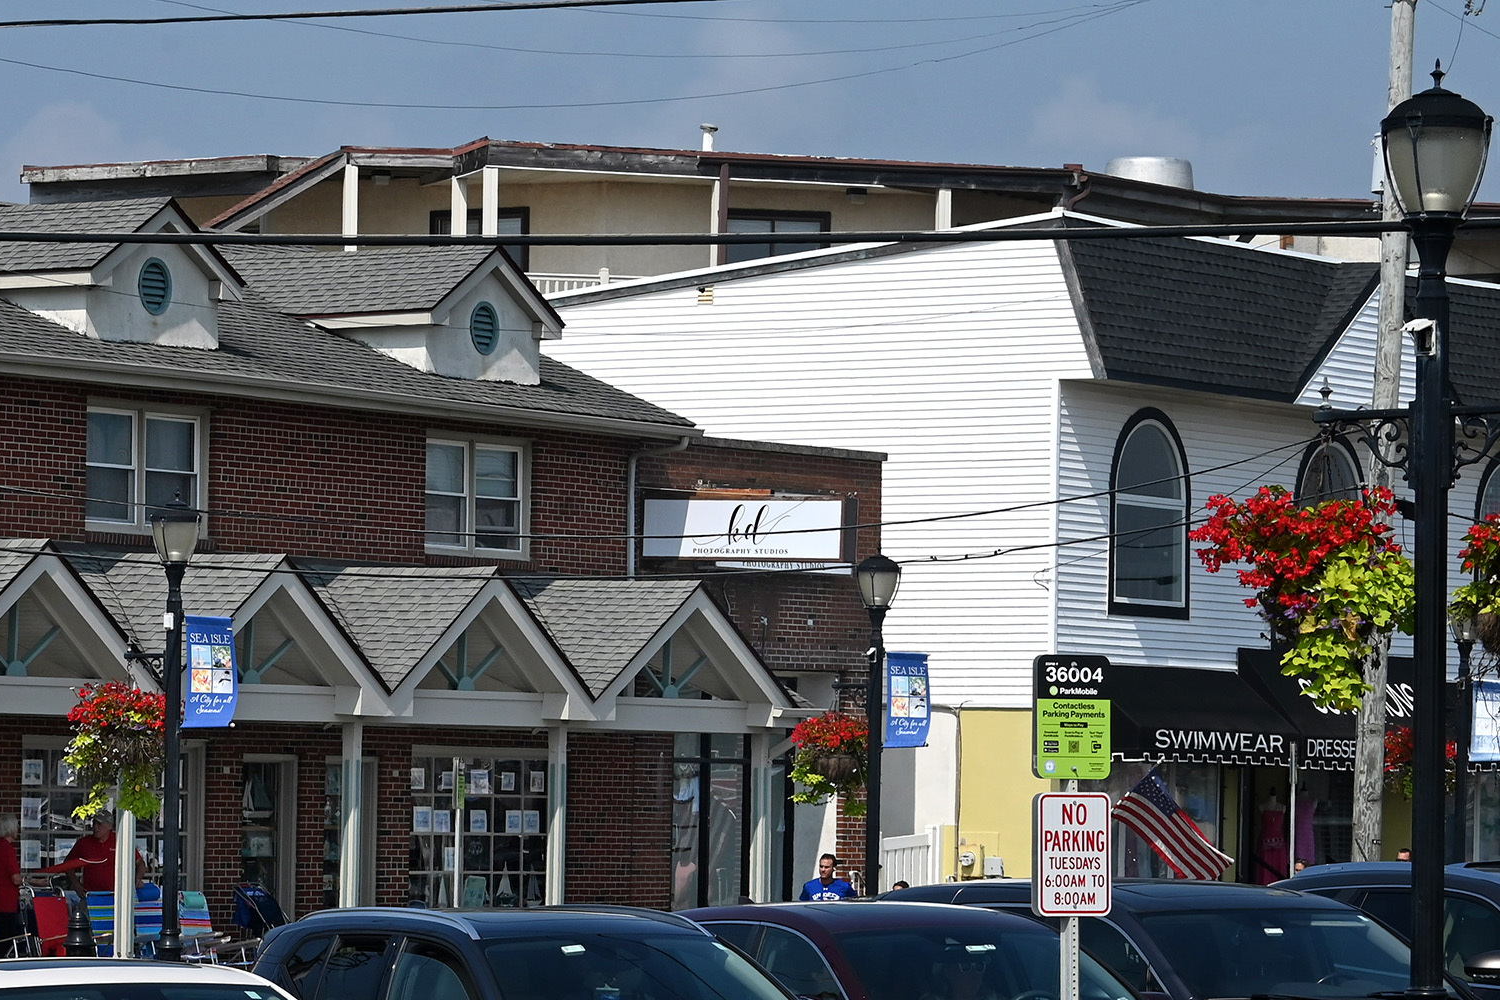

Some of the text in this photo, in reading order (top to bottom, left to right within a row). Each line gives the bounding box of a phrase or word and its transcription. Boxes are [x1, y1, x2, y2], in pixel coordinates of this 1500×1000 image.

[692, 547, 751, 555] PHOTOGRAPHY
[189, 632, 231, 645] SEA ISLE
[890, 665, 926, 676] SEA ISLE
[1045, 666, 1104, 683] 36004
[1059, 687, 1098, 696] ParkMobile
[200, 693, 212, 707] City
[213, 695, 222, 707] for
[1052, 701, 1095, 710] Contactless
[1042, 710, 1106, 719] Parking Payments
[898, 718, 909, 730] City
[1155, 729, 1284, 754] SWIMWEAR
[1061, 803, 1088, 826] NO
[1044, 830, 1105, 852] PARKING
[1049, 856, 1101, 870] TUESDAYS
[1044, 874, 1105, 888] 6:00AM TO
[1054, 891, 1096, 905] 8:00AM
